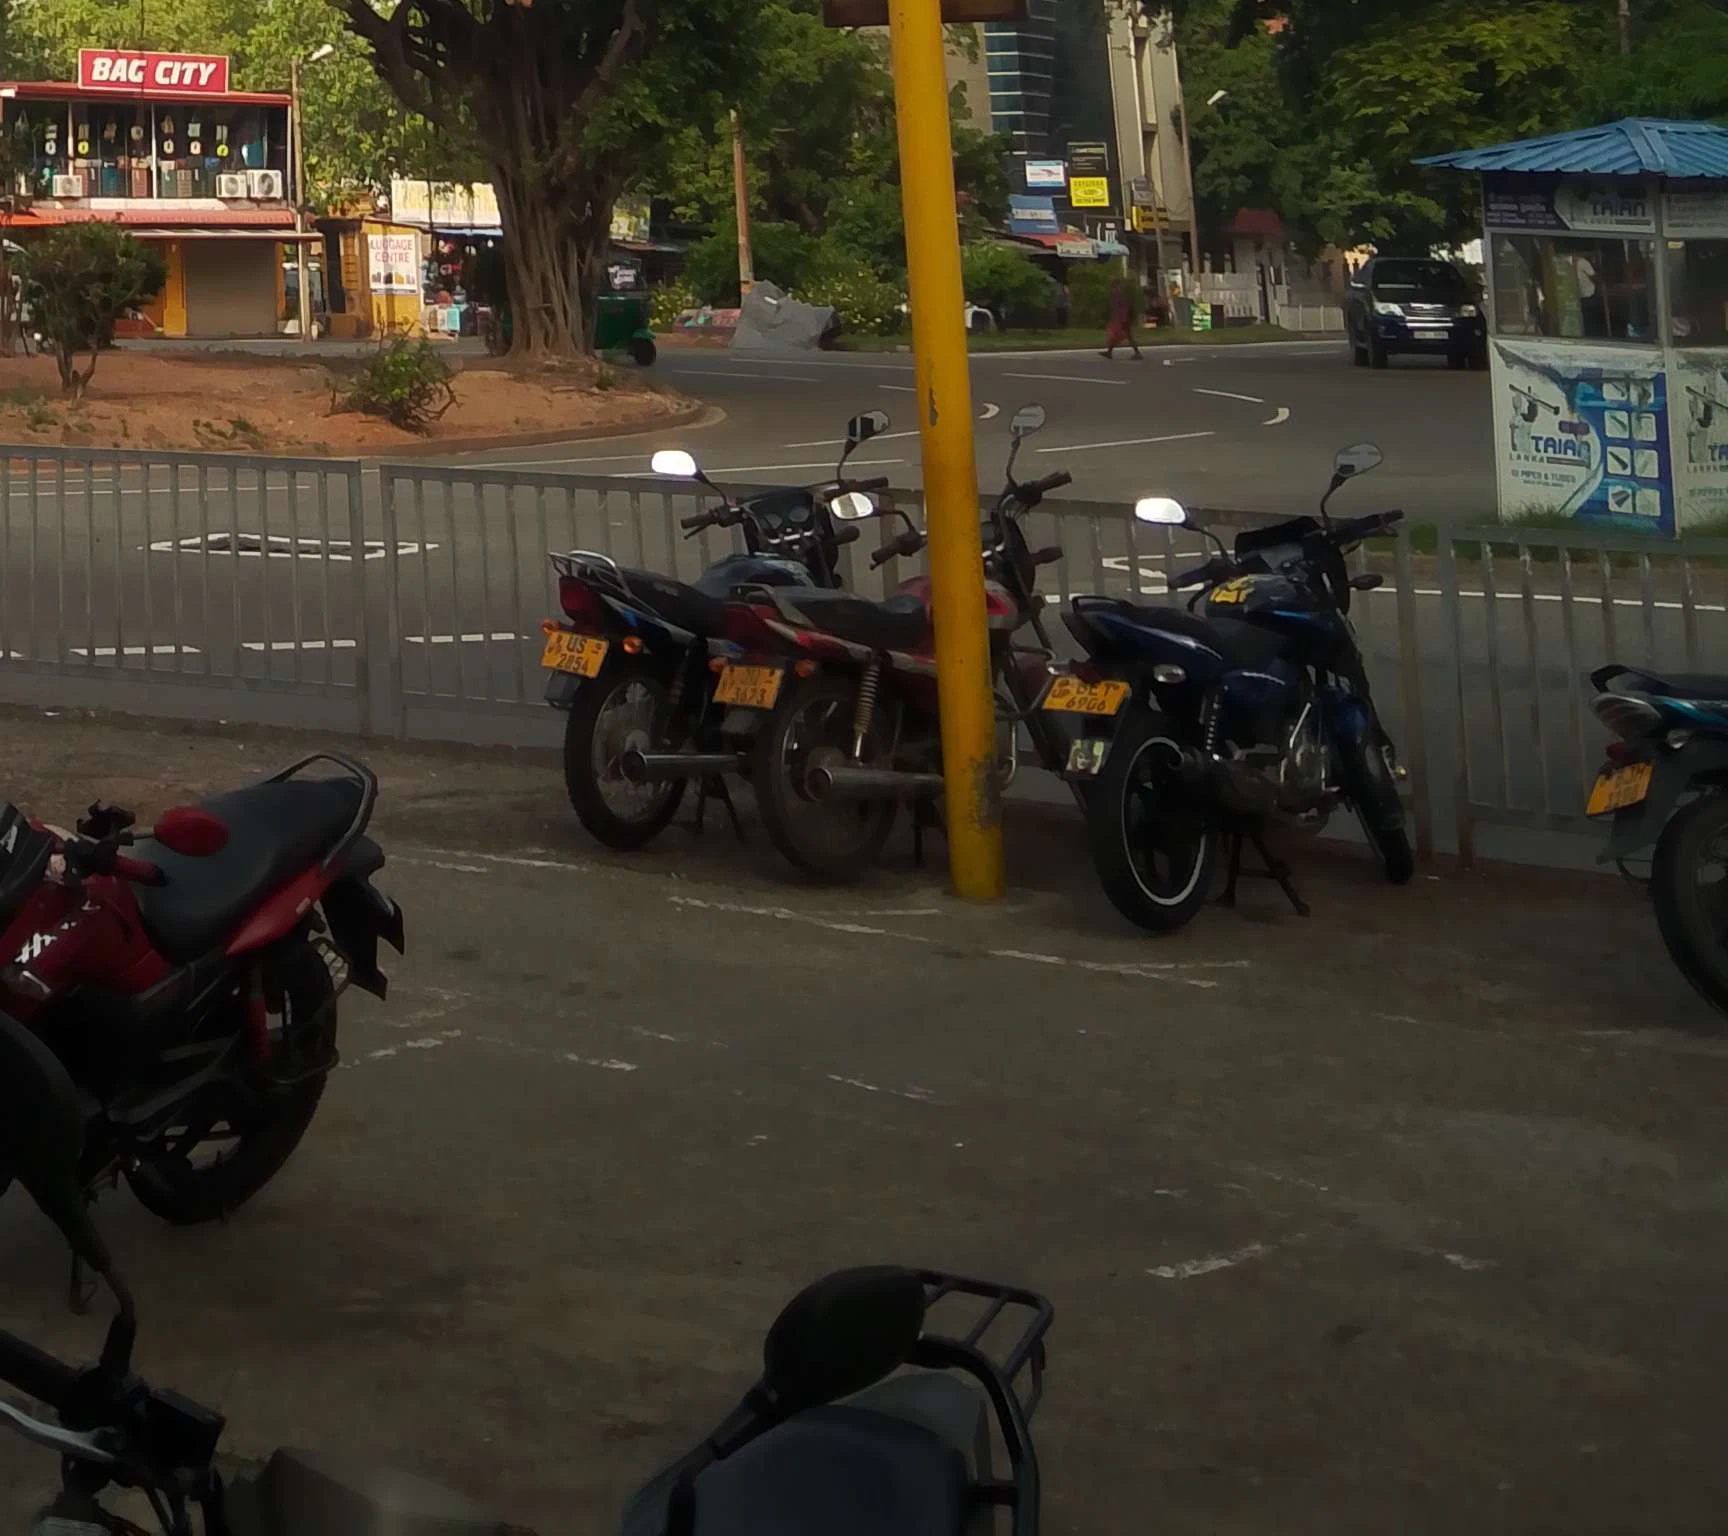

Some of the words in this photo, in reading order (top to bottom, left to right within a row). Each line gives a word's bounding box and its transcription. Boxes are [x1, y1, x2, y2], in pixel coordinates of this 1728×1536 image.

[91, 57, 147, 83] BAG
[154, 60, 217, 86] CITY
[370, 237, 414, 250] LUGGAGE
[1509, 453, 1545, 464] LANKA
